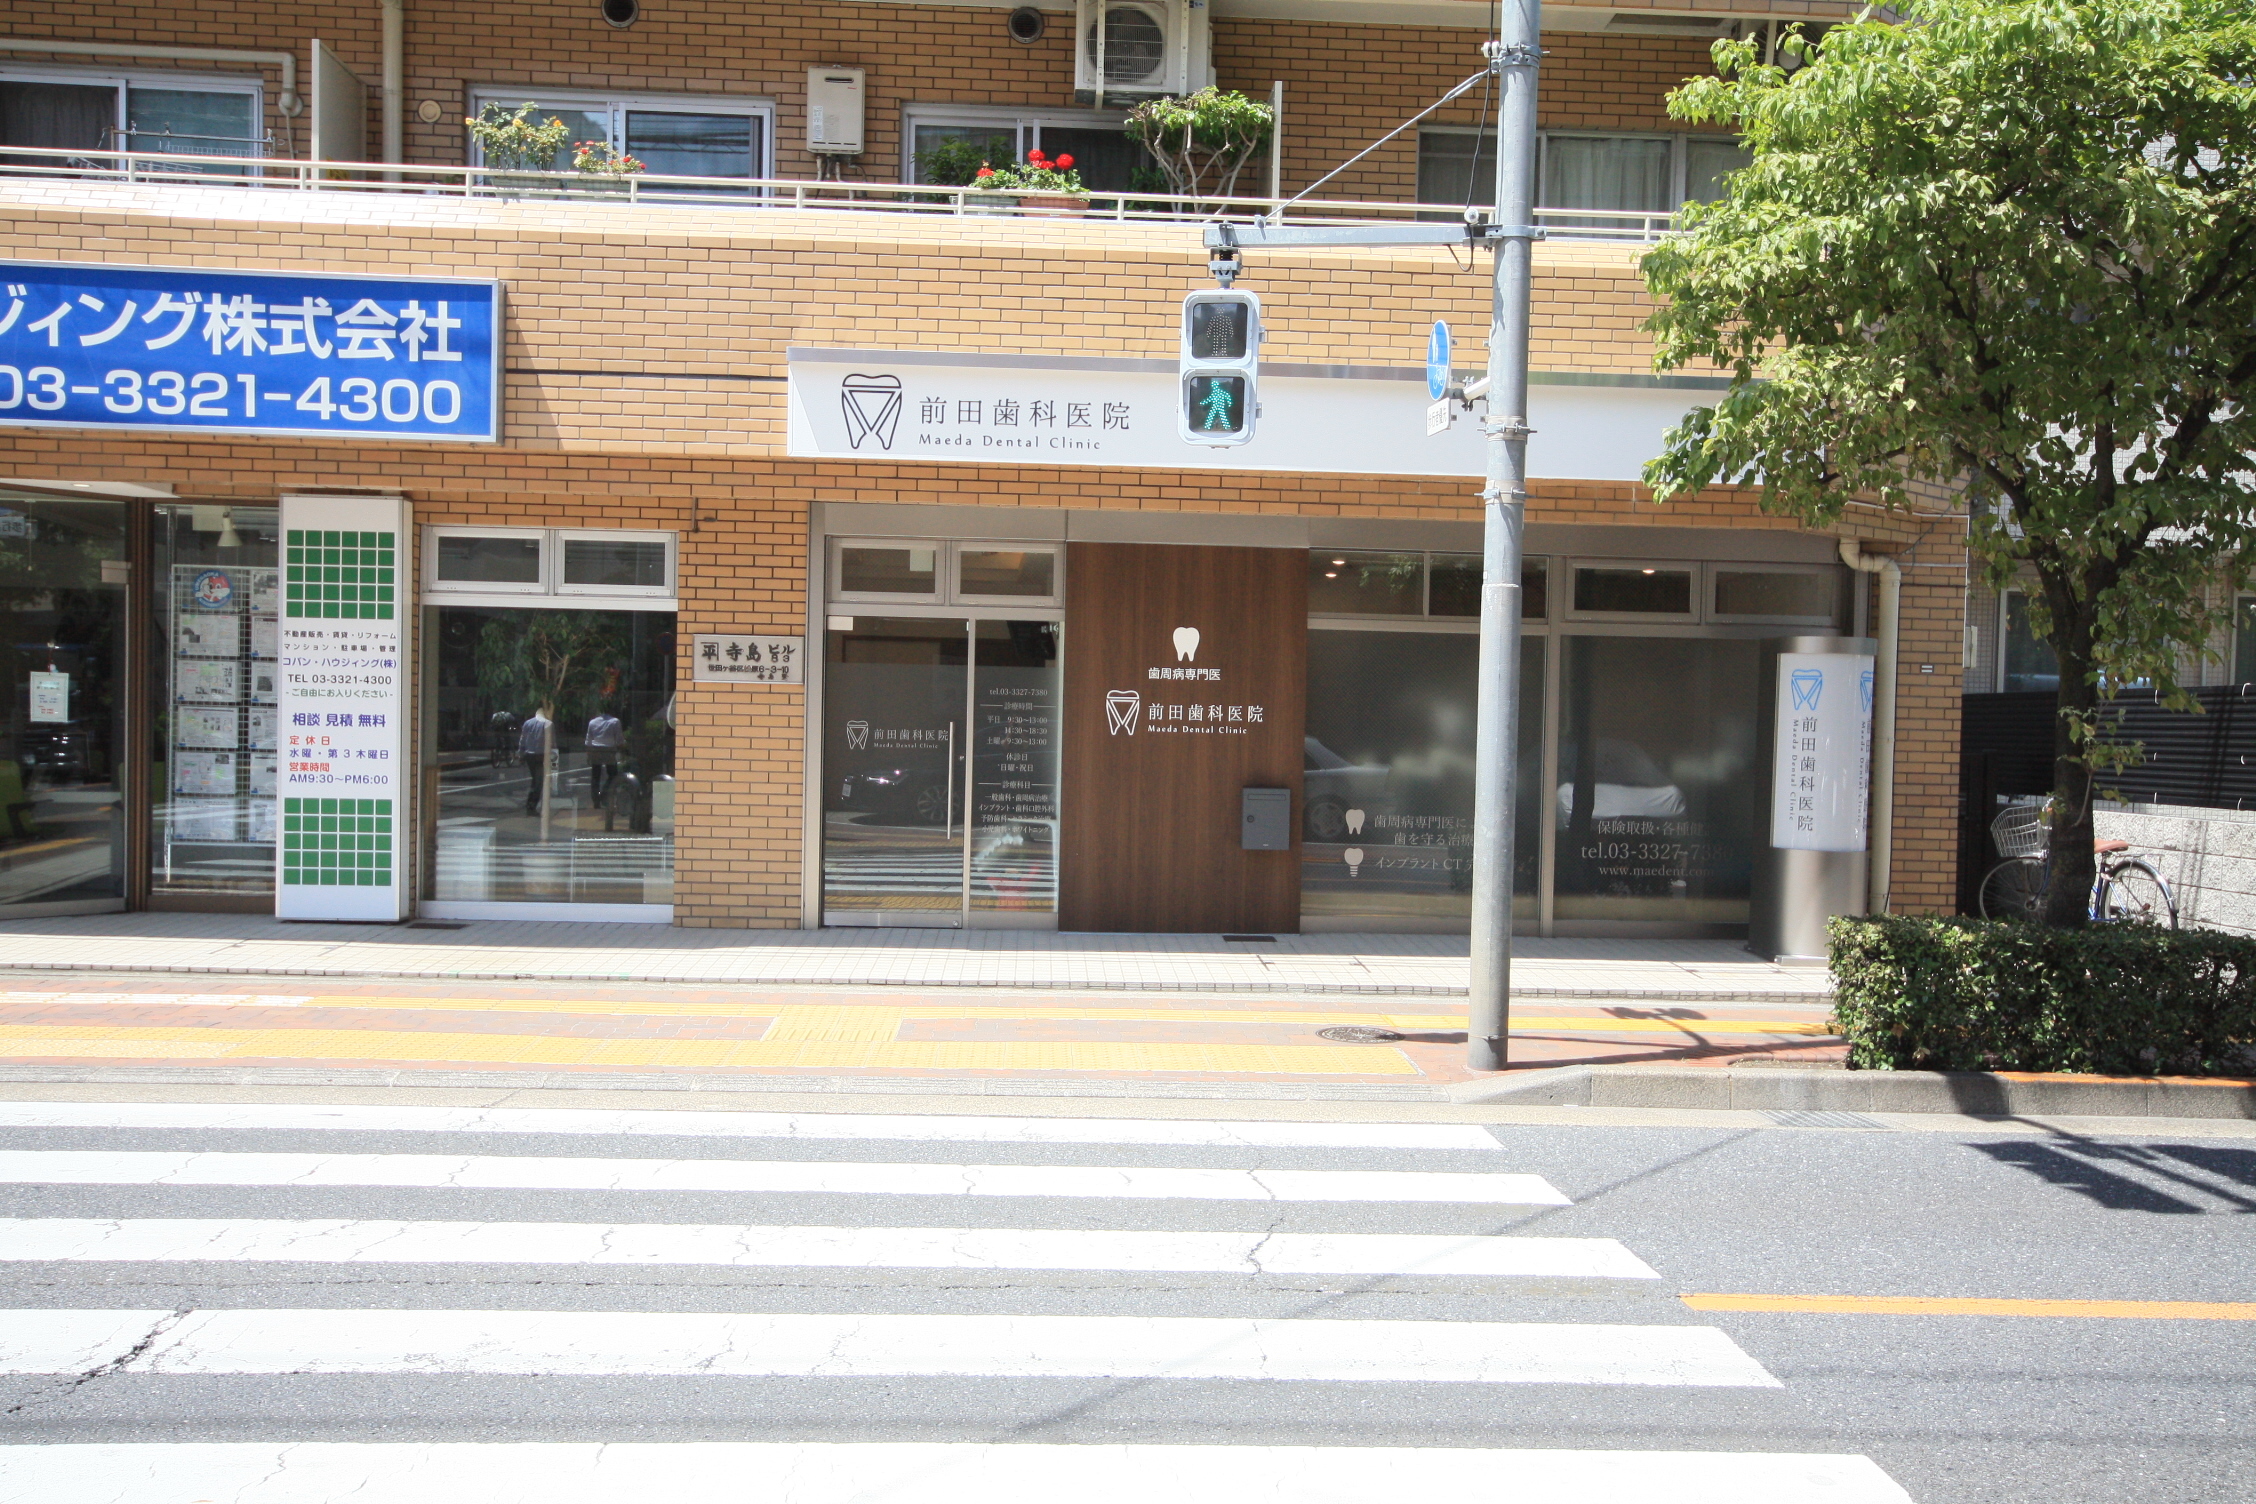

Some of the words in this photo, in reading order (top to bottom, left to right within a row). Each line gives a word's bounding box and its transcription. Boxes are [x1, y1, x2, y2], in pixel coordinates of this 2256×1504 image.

[919, 396, 1131, 430] 前田歯科医院
[918, 433, 973, 446] Maeda
[982, 435, 1040, 448] Dental
[1049, 437, 1102, 450] Clinic
[287, 673, 309, 683] TEL
[311, 674, 392, 685] 03-3321-4300
[1148, 667, 1221, 681] 歯周病専門医
[989, 687, 1048, 697] tel.03-3327-7380
[1003, 701, 1033, 711] 診療時間
[1148, 702, 1264, 723] 前田歯科医院
[292, 712, 321, 727] 相談
[325, 713, 354, 727] 見積
[358, 713, 386, 728] 無料
[987, 715, 1000, 724] 平日
[873, 728, 949, 741] 前田歯科医院
[1147, 724, 1178, 734] Maeda
[1182, 725, 1214, 734] Dental
[1218, 726, 1247, 734] Clinic
[1791, 719, 1799, 750] Maeda
[289, 735, 331, 746] 定休日
[986, 736, 1001, 745] 土曜
[1006, 752, 1028, 762] 休診日
[289, 762, 330, 772] 営業時間
[1790, 754, 1798, 787] Dental
[1797, 716, 1818, 832] 前田歯科医院
[1002, 780, 1031, 789] 診療科目
[1788, 791, 1797, 821] Clinic
[1374, 815, 1474, 829] 歯周病専門医に
[1598, 820, 1709, 836] 保険取扱・各種健
[1375, 856, 1439, 870] インプラント
[1443, 859, 1463, 870] CT
